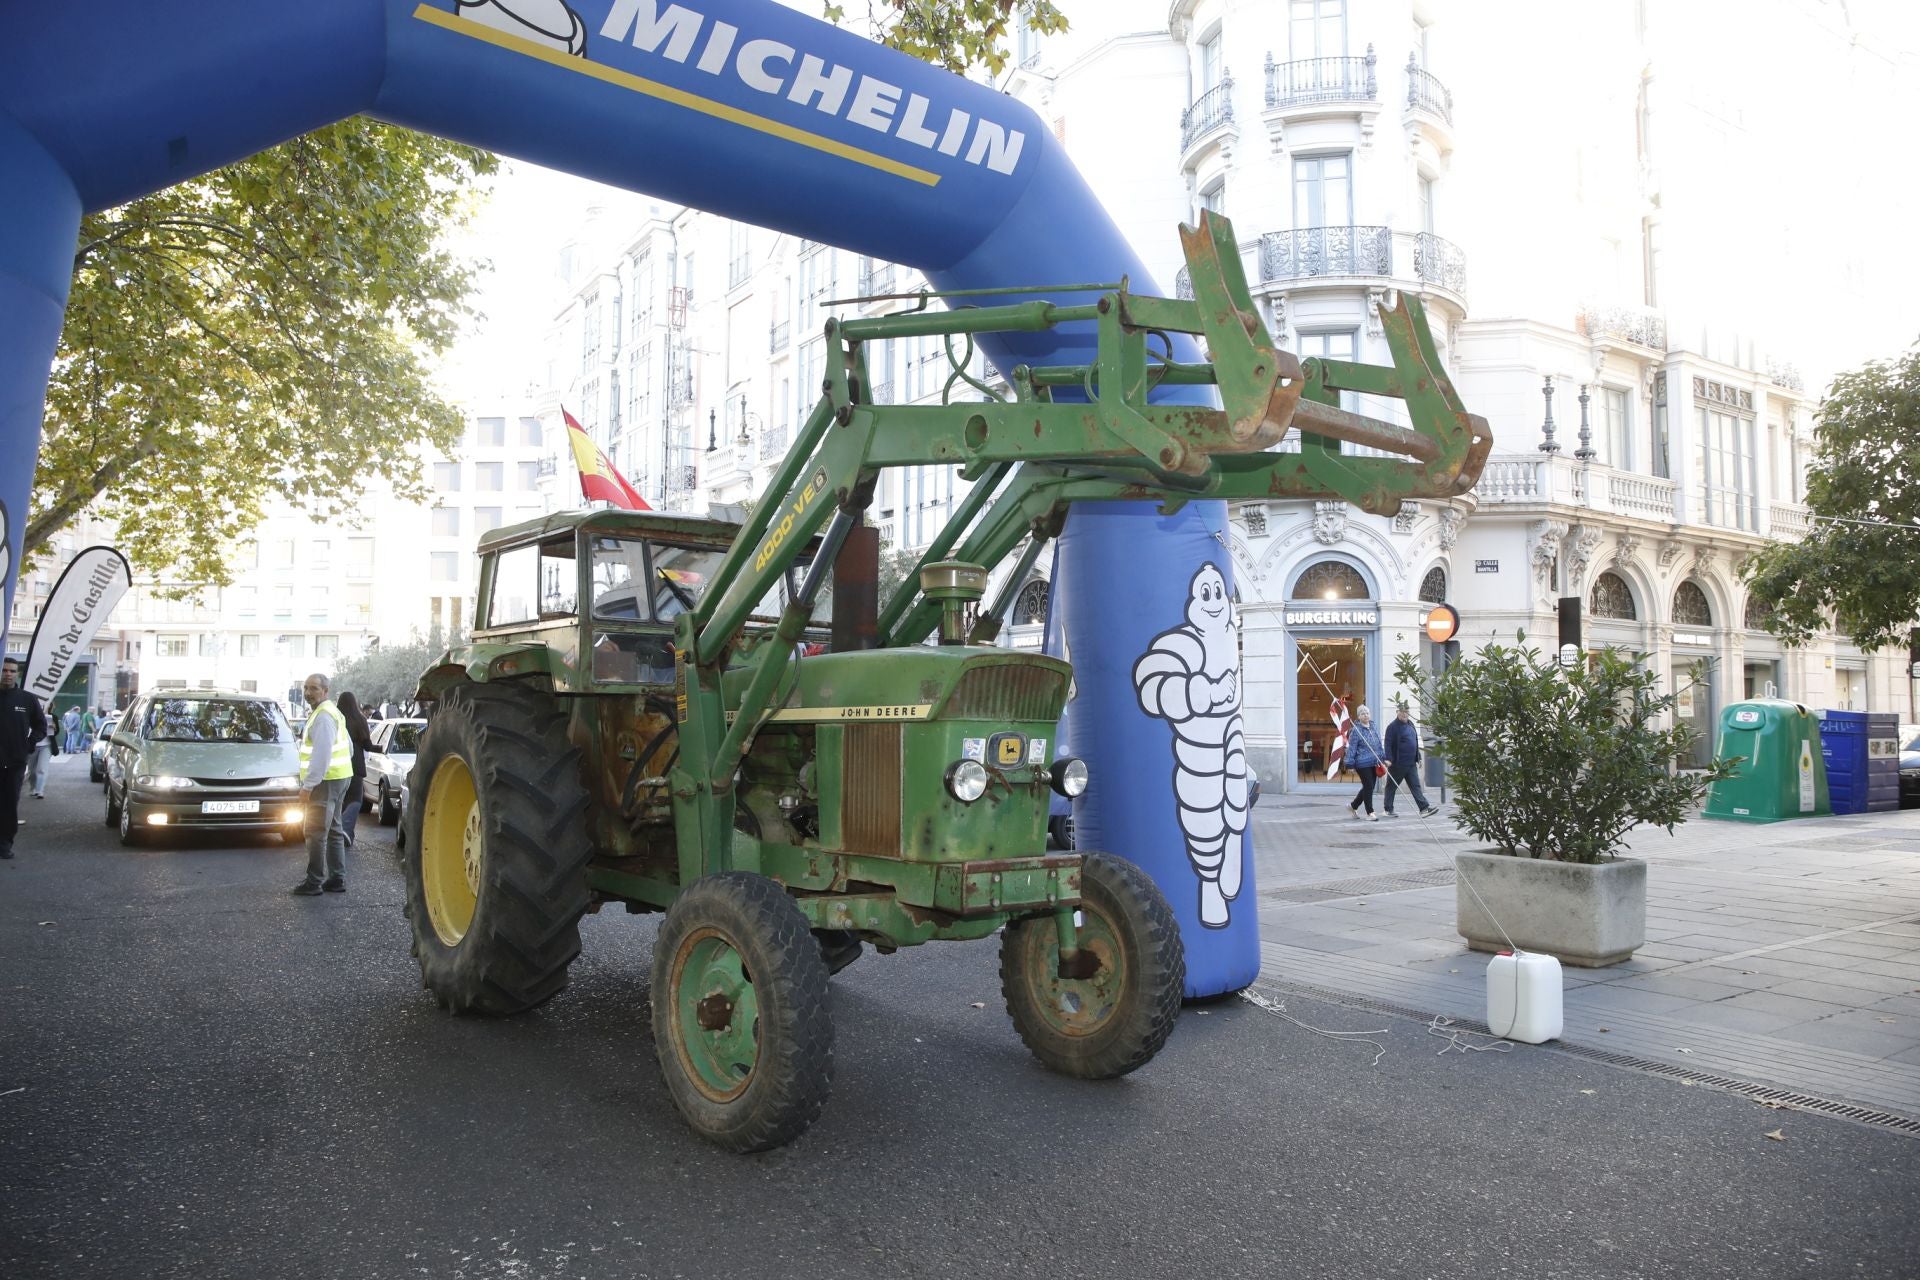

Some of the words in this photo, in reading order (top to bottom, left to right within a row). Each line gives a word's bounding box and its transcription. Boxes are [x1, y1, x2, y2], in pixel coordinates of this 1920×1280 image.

[600, 0, 1025, 176] MICHELIN
[755, 482, 815, 573] 4000-VE
[32, 644, 73, 692] Norte
[59, 624, 82, 645] de
[72, 557, 121, 624] Castilla
[841, 707, 870, 717] JOHN
[877, 707, 916, 717] DEERE
[209, 802, 235, 812] 4075
[238, 802, 256, 811] BLF
